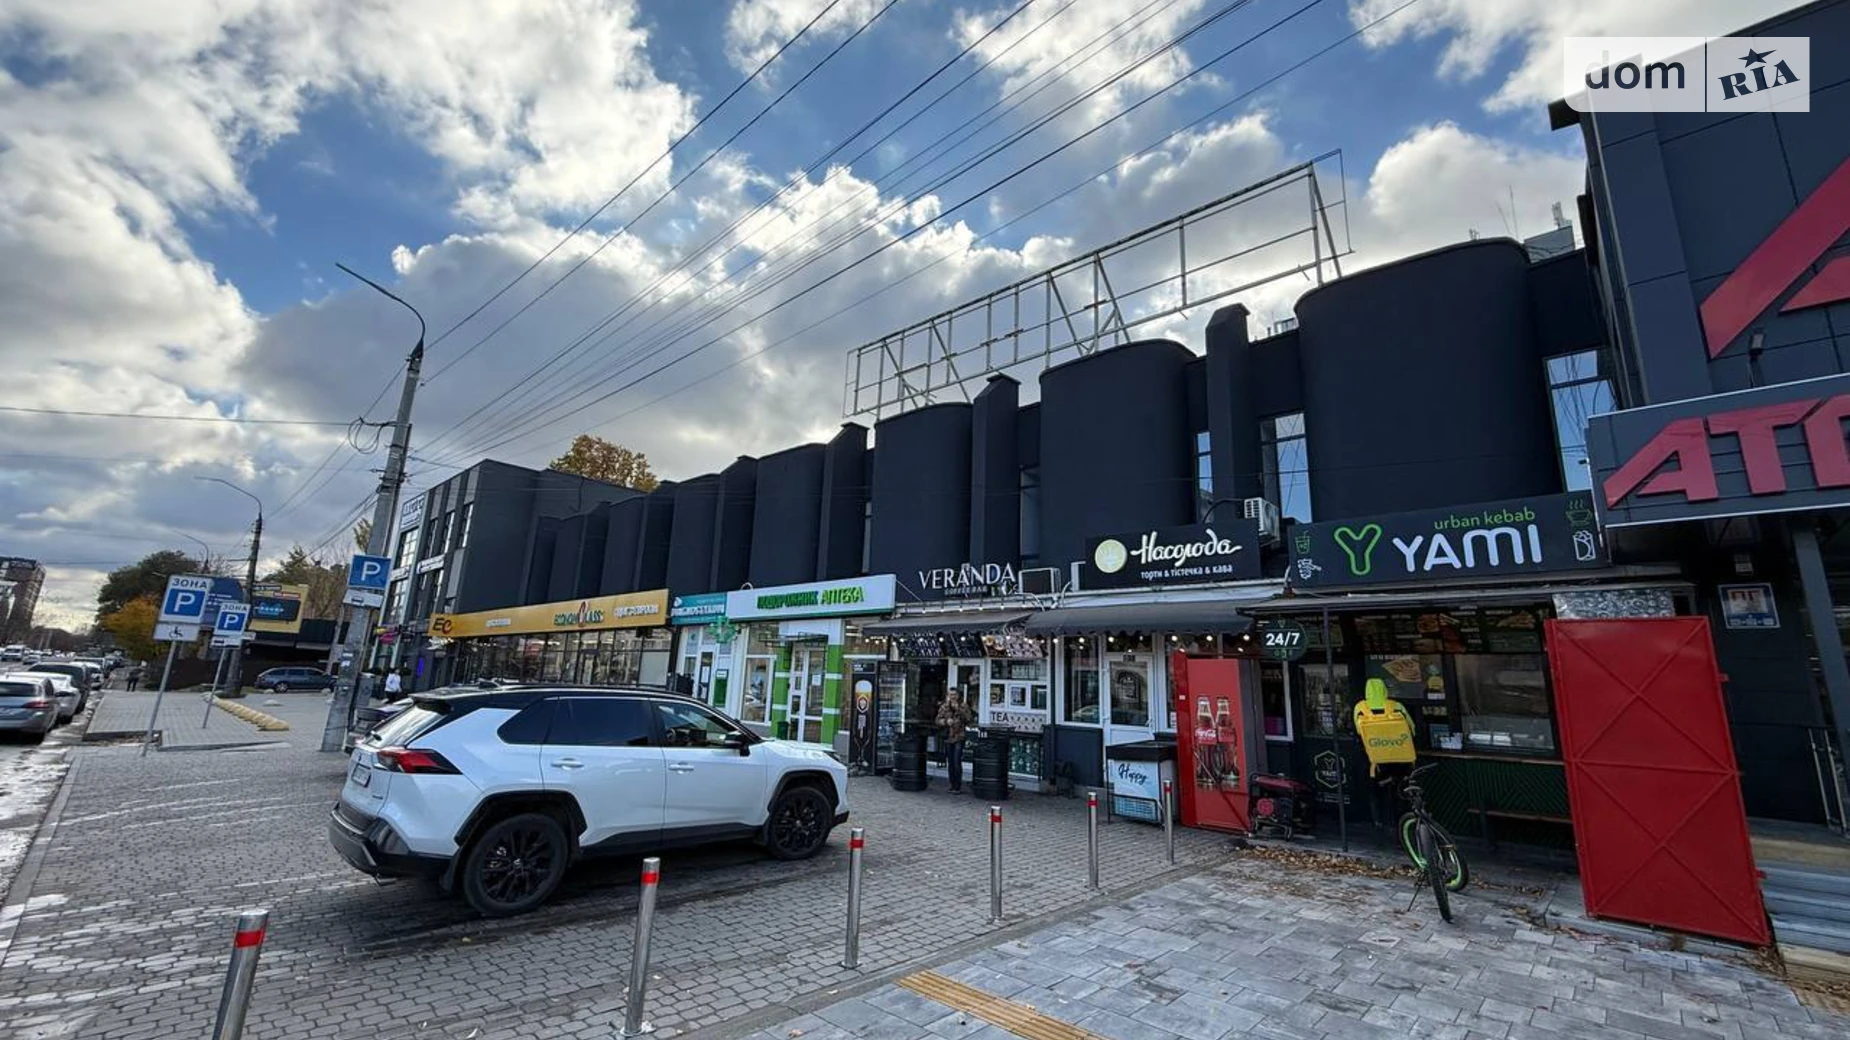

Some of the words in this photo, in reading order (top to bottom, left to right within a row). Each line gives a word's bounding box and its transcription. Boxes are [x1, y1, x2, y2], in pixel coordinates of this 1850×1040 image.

[1434, 514, 1480, 531] urban
[1484, 507, 1537, 526] kebab
[1130, 528, 1243, 568] Насолода
[1392, 523, 1543, 573] YAMI
[918, 562, 1016, 590] VERANDA
[1140, 570, 1163, 581] торти
[1171, 566, 1203, 578] тістечка
[1212, 564, 1233, 574] кава
[172, 577, 208, 589] ЗОНА
[222, 604, 248, 612] ЗОНА
[1265, 632, 1300, 647] 24/7
[991, 711, 1010, 722] TEA
